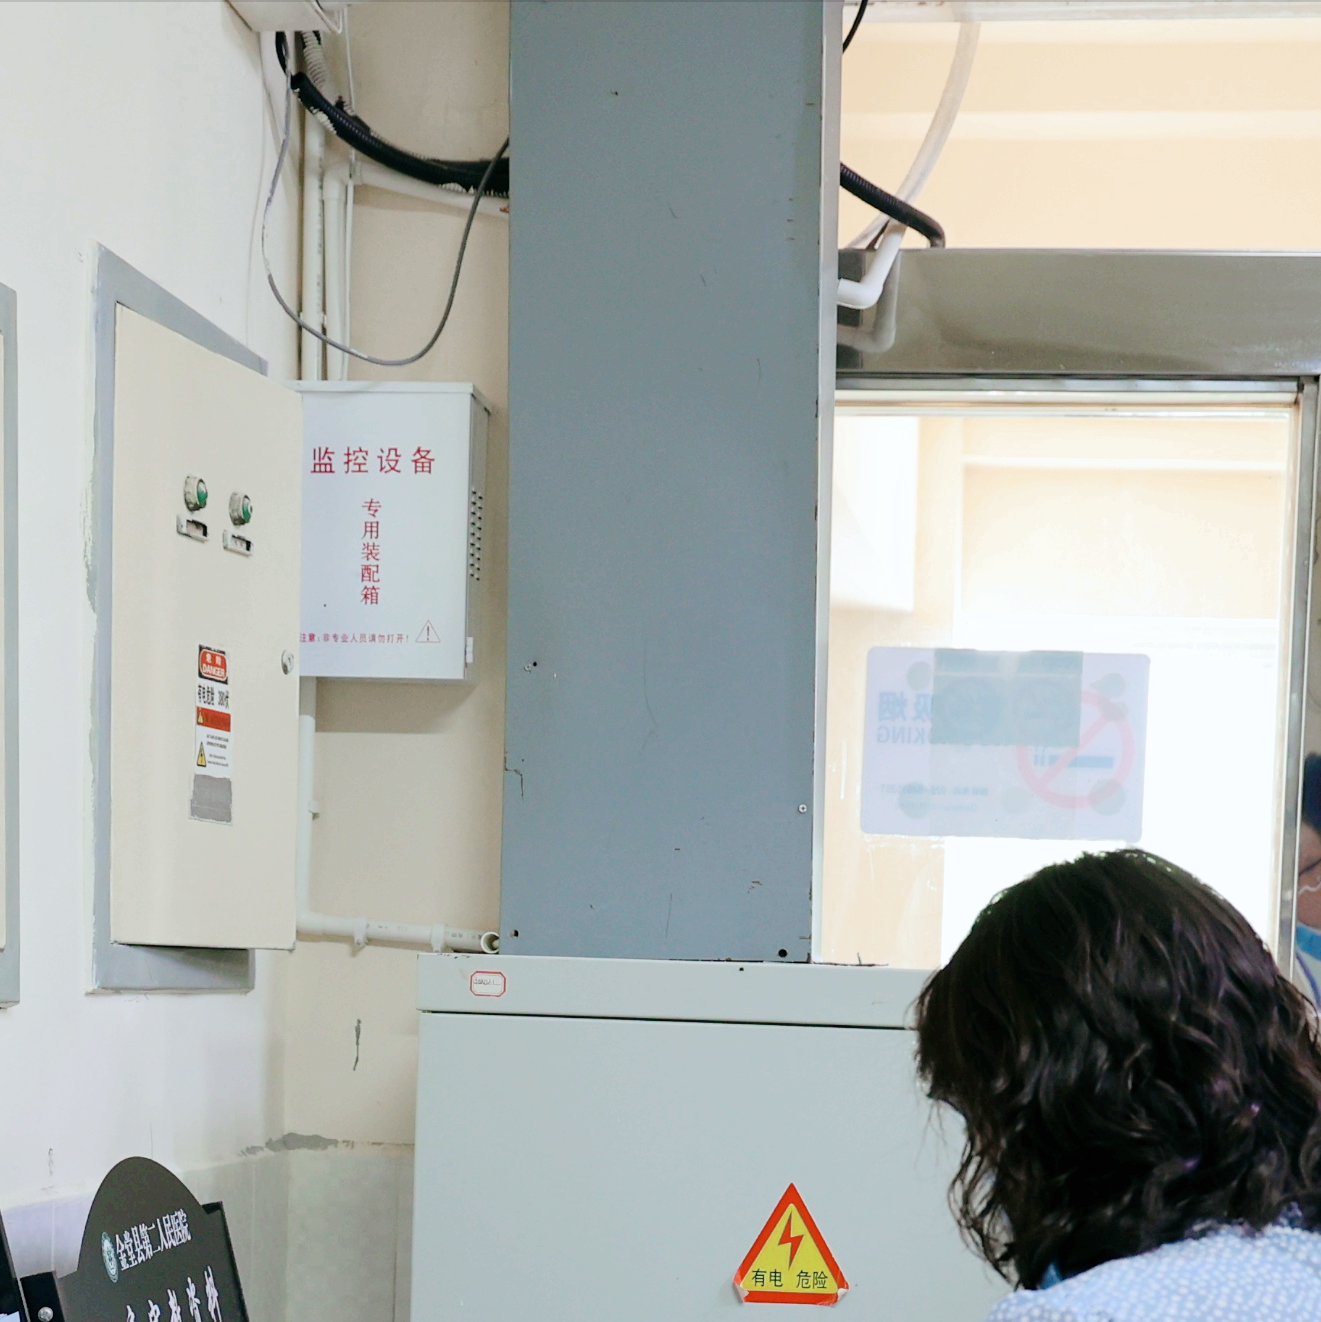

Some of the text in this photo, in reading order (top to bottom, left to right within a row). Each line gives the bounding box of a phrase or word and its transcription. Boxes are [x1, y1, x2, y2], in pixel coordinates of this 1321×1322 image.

[310, 446, 435, 474] 监控设备
[360, 498, 382, 605] 专用装配箱
[202, 662, 225, 678] DANGER
[115, 1208, 191, 1271] 金堂县第二人民医院
[751, 1268, 828, 1290] 有电 危险
